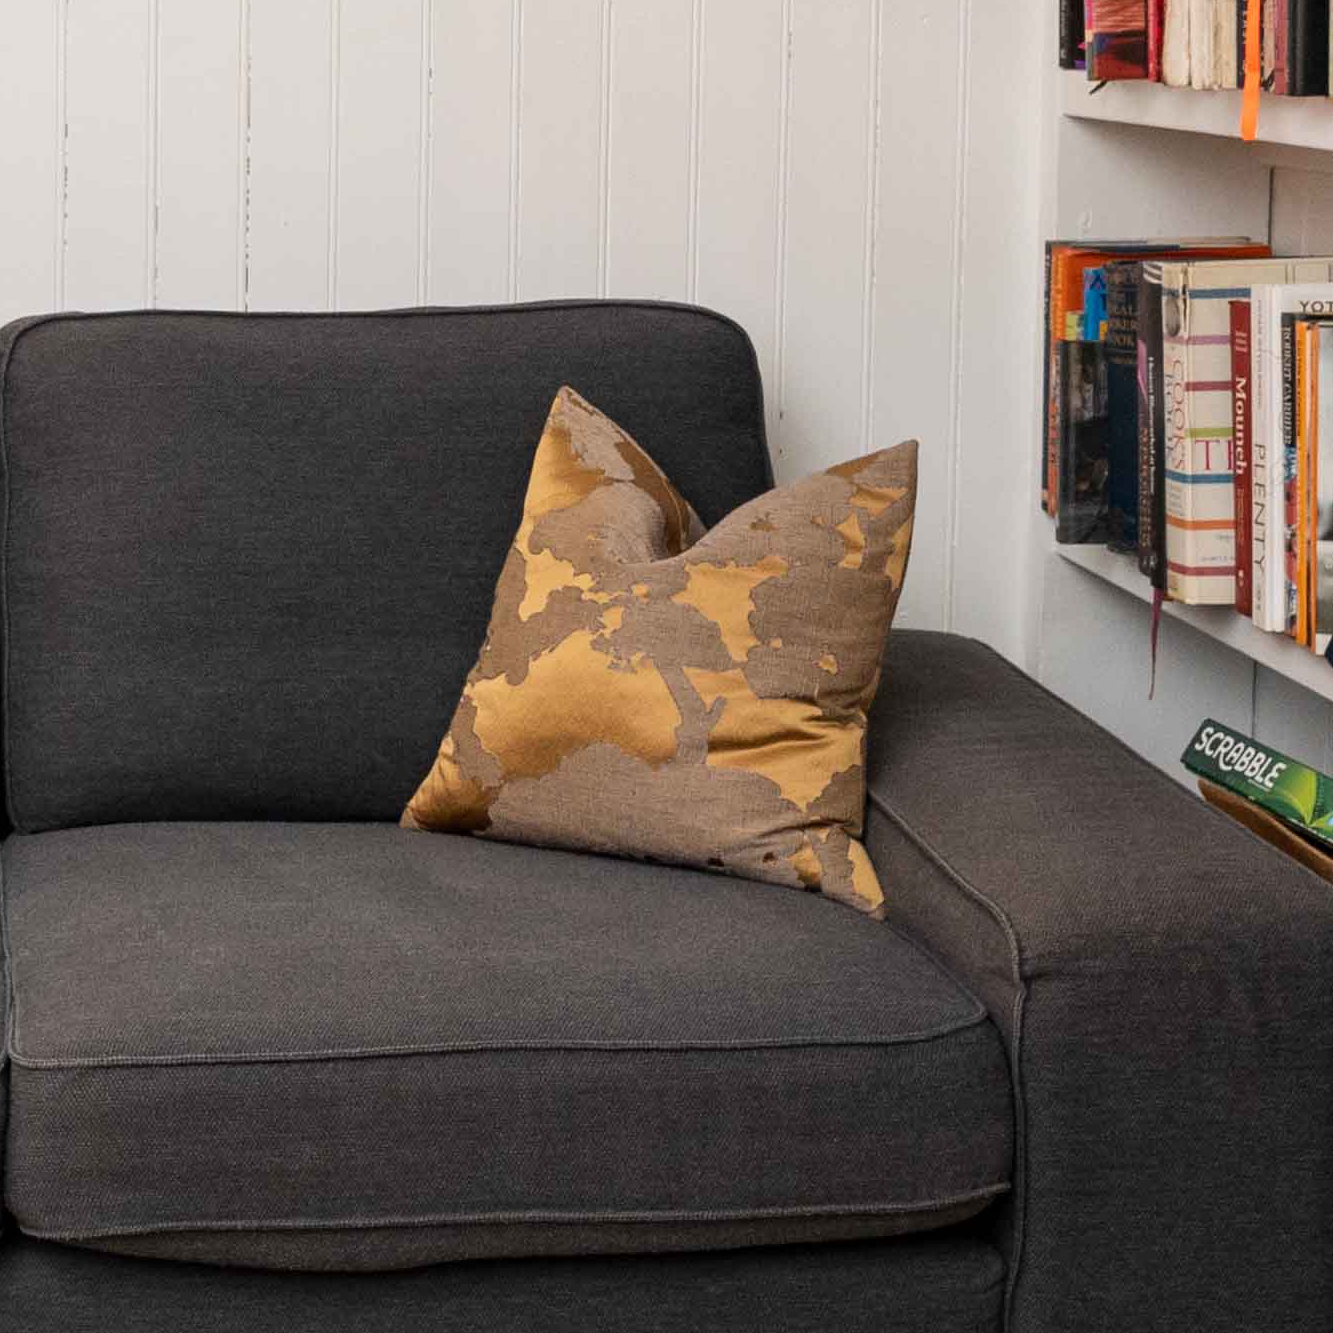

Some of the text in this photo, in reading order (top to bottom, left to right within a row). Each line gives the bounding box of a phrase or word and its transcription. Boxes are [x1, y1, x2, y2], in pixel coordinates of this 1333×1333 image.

[1283, 325, 1293, 445] ROBERT CARRIER
[1254, 443, 1266, 577] PLENTY
[1195, 726, 1287, 788] SCRABBLE
